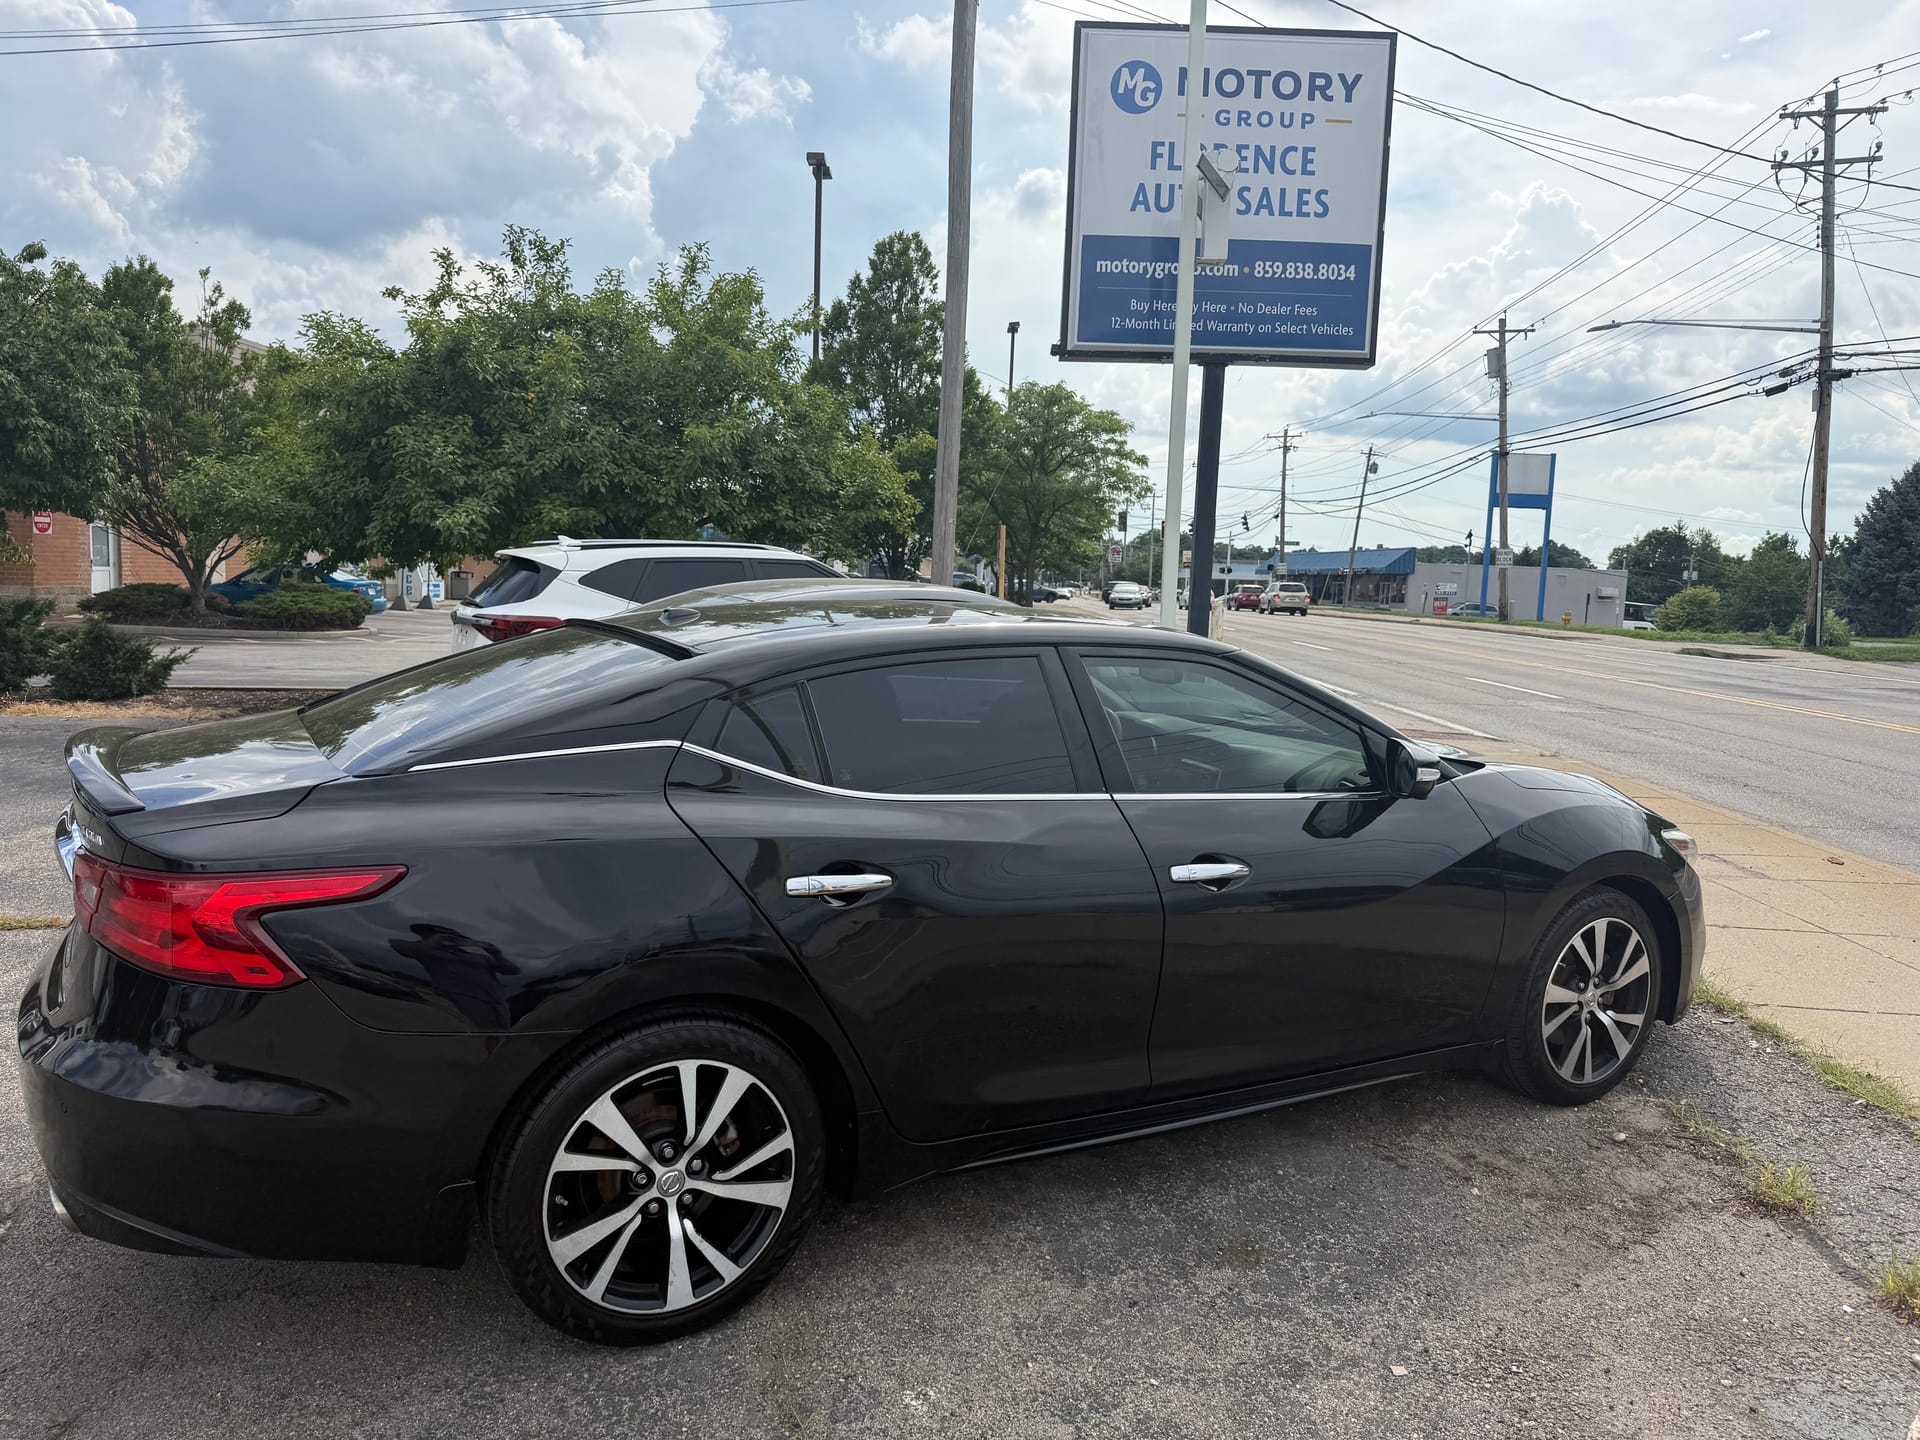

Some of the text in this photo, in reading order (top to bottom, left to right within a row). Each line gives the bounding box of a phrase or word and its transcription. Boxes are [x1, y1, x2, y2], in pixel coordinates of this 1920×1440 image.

[1117, 67, 1156, 107] MG
[1214, 109, 1316, 129] GROUP
[1150, 141, 1317, 176] FLENCE
[1235, 186, 1330, 218] SALES
[1096, 258, 1356, 281] motorygro.com 859.838.8034
[1130, 299, 1150, 314] Buy
[1153, 299, 1177, 312] Here
[1202, 301, 1227, 313] Here
[1238, 302, 1254, 314] No
[1257, 302, 1292, 316] Dealer
[1294, 304, 1318, 316] Fees
[1111, 317, 1160, 330] 12-Month
[1206, 319, 1255, 336] Warranty
[1258, 323, 1272, 334] on
[1275, 322, 1307, 334] Select
[1311, 323, 1354, 336] Vehicles
